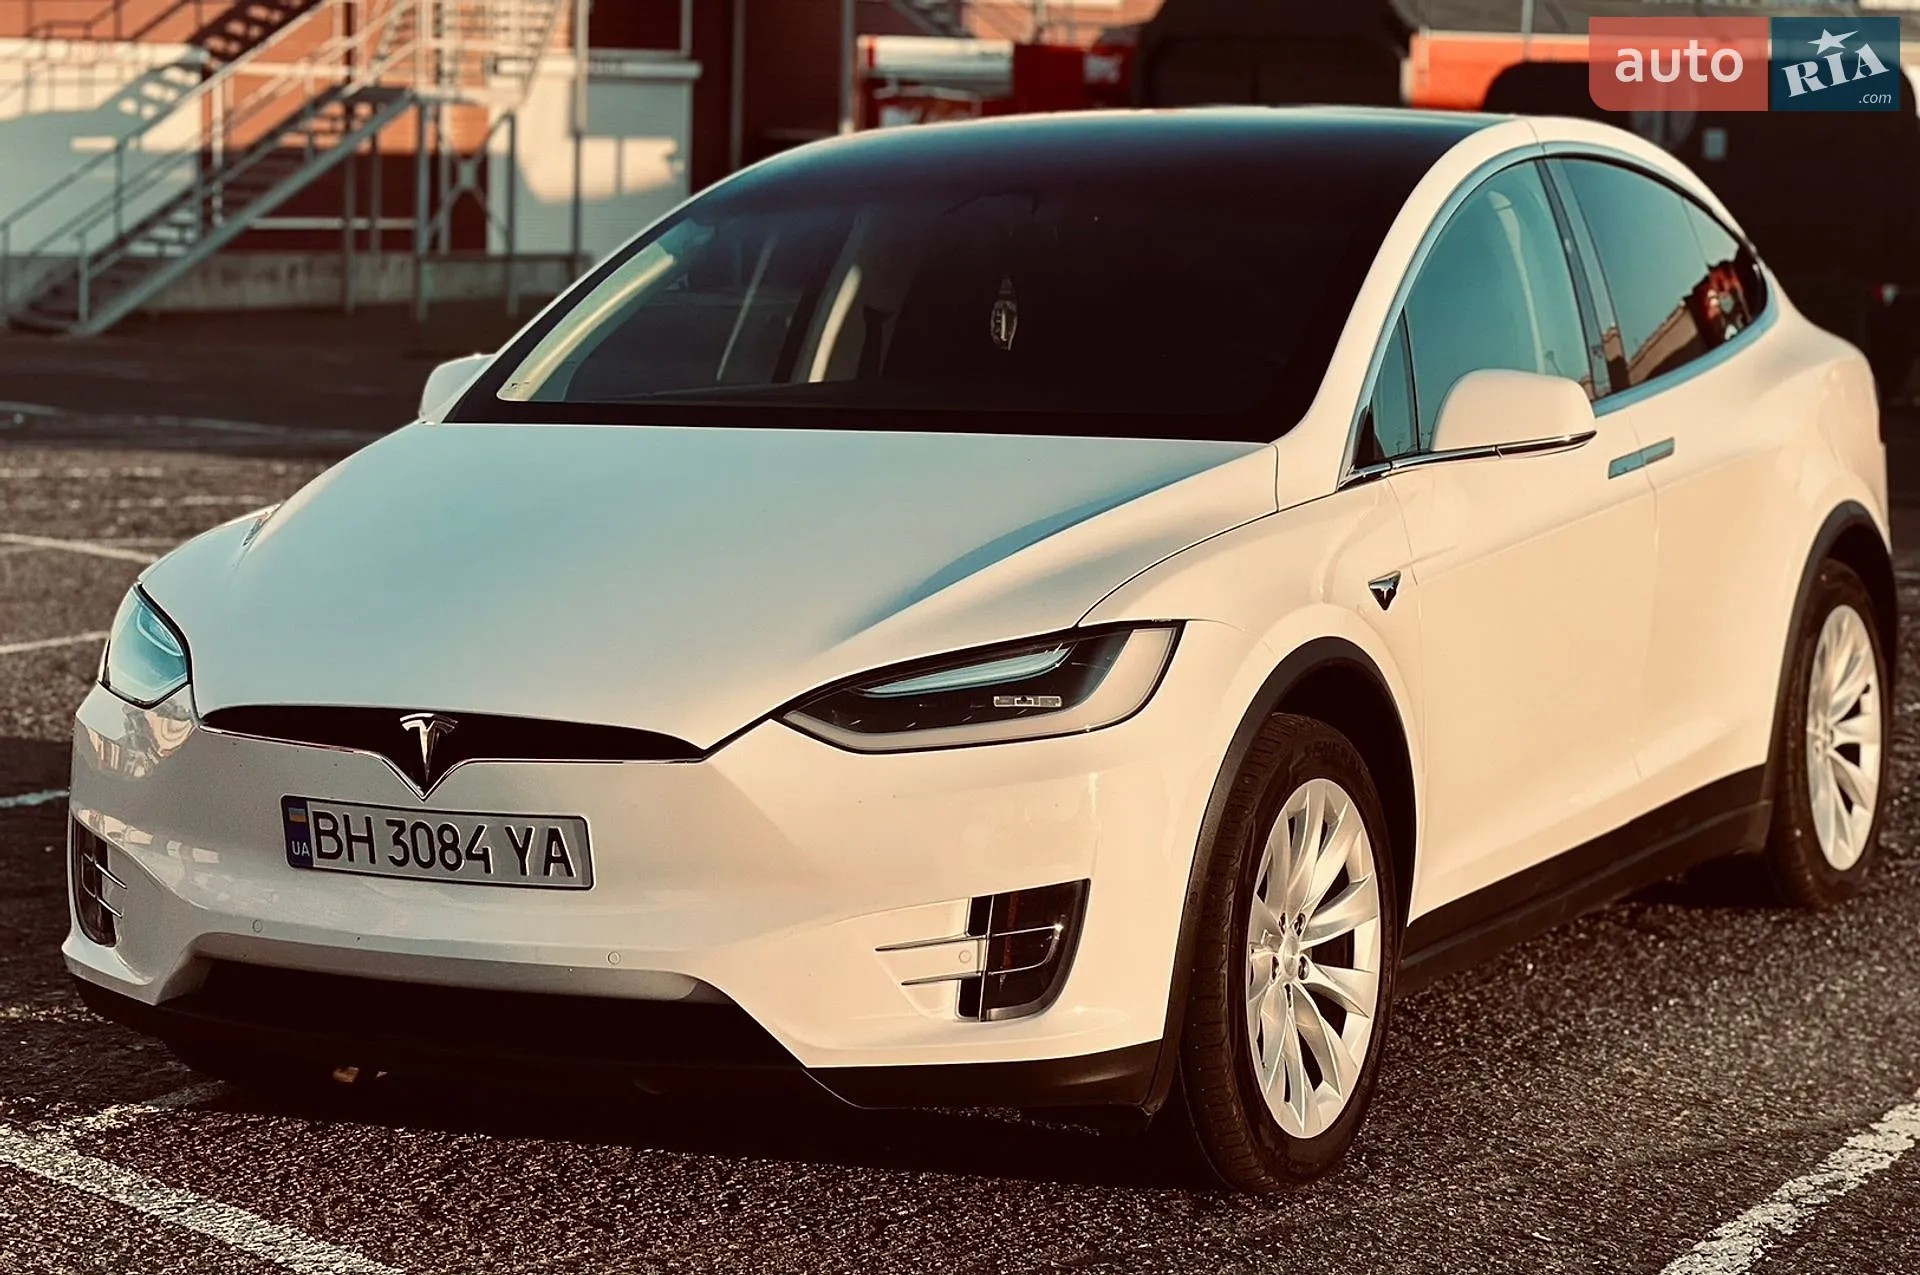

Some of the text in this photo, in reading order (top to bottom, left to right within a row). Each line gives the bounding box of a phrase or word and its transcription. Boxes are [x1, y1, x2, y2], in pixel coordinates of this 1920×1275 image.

[292, 841, 310, 857] UA
[312, 811, 576, 877] BH 3084 YA
